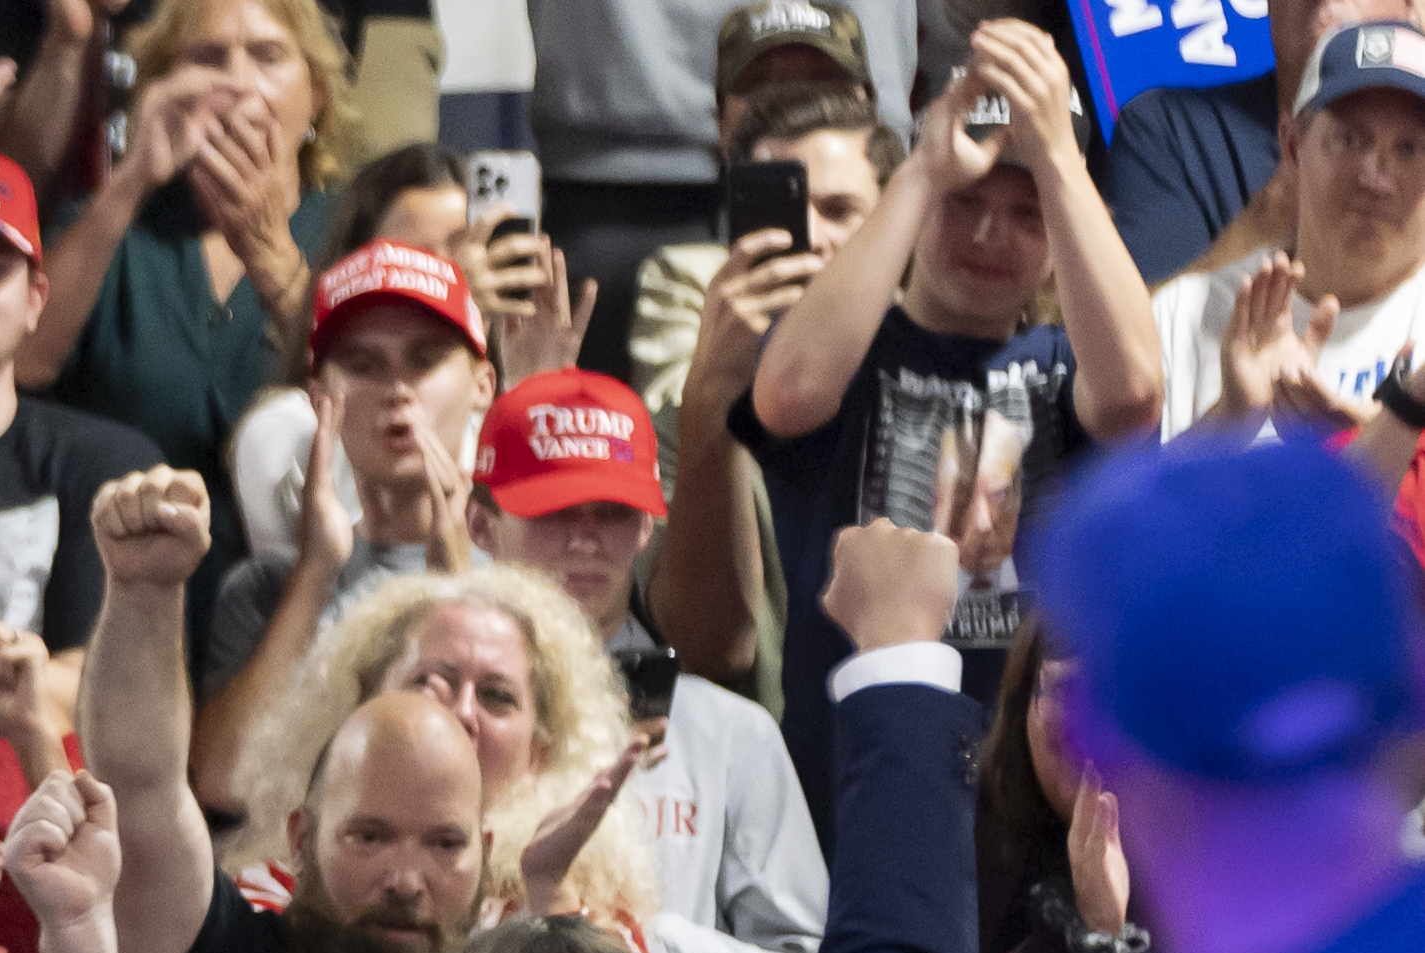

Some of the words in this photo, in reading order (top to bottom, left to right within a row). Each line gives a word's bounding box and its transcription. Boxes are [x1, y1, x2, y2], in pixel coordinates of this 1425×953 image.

[373, 242, 457, 285] AMERICA
[388, 267, 449, 301] AGAIN
[527, 403, 635, 442] TRUMP
[528, 435, 611, 461] VANCE
